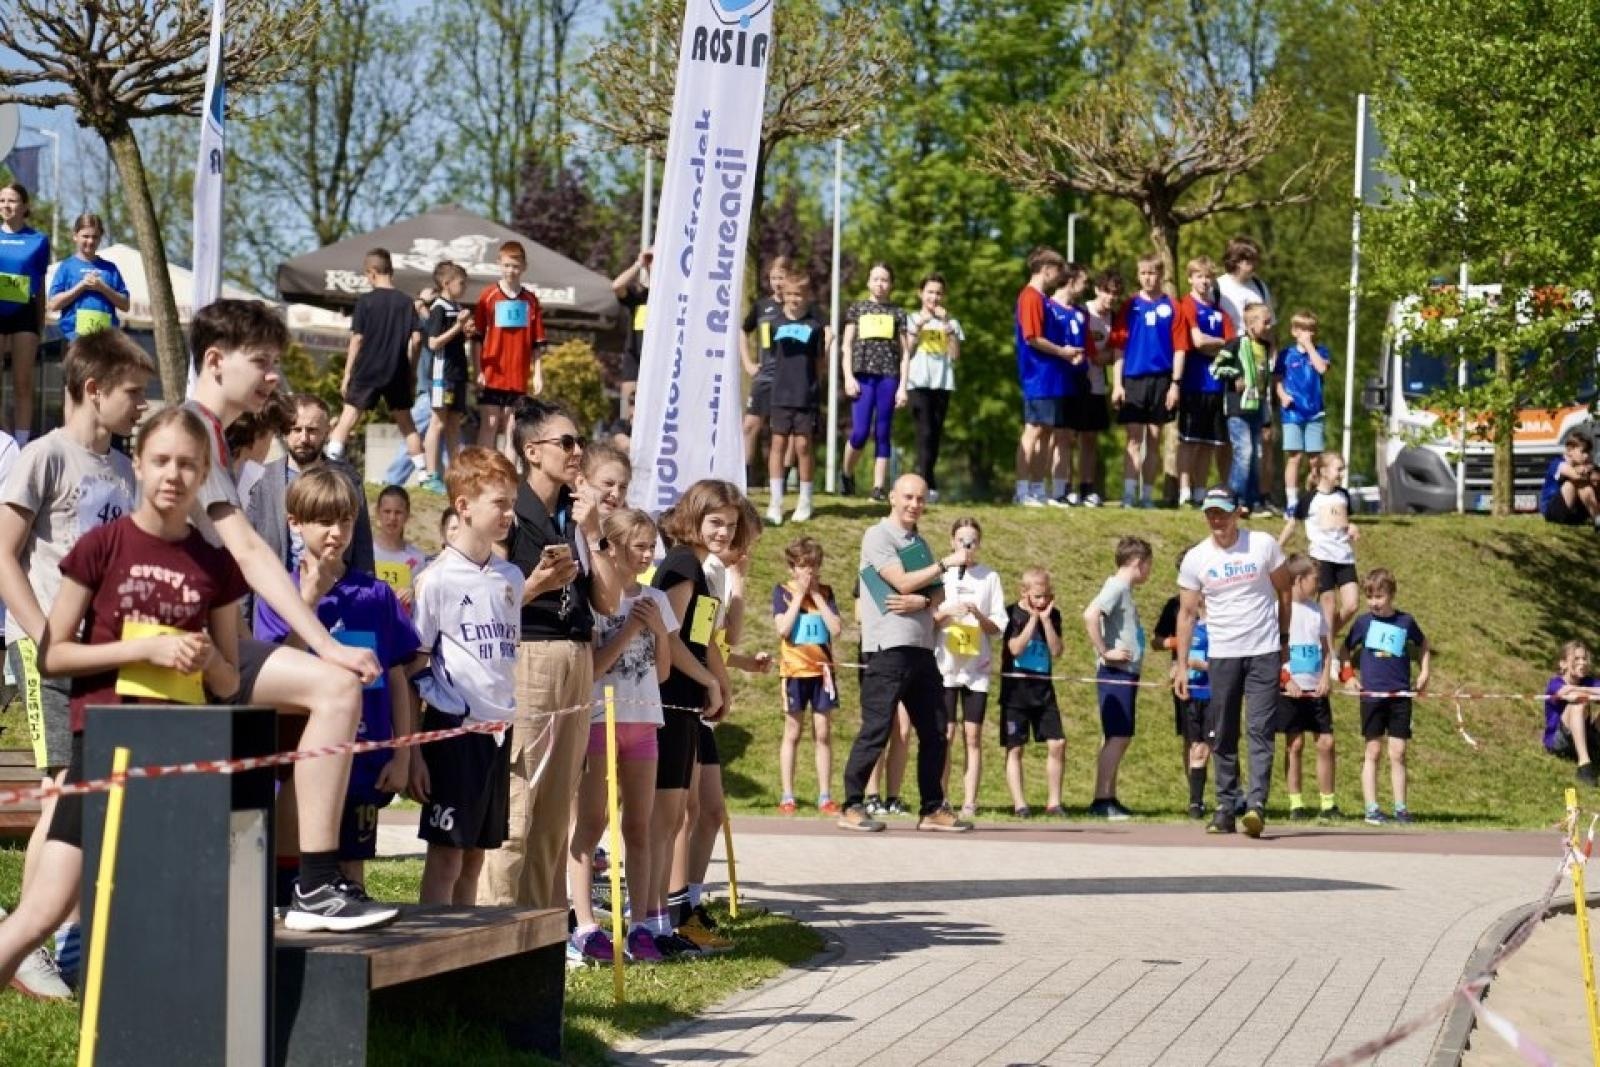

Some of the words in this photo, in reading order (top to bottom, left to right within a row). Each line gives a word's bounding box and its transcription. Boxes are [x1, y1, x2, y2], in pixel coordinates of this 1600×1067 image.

[706, 147, 747, 334] Rekreacji
[129, 564, 186, 589] every
[182, 584, 201, 603] is
[805, 623, 818, 636] 11
[1380, 632, 1396, 645] 15
[1301, 646, 1315, 659] 15
[27, 679, 41, 741] CHASING
[429, 803, 456, 831] 36
